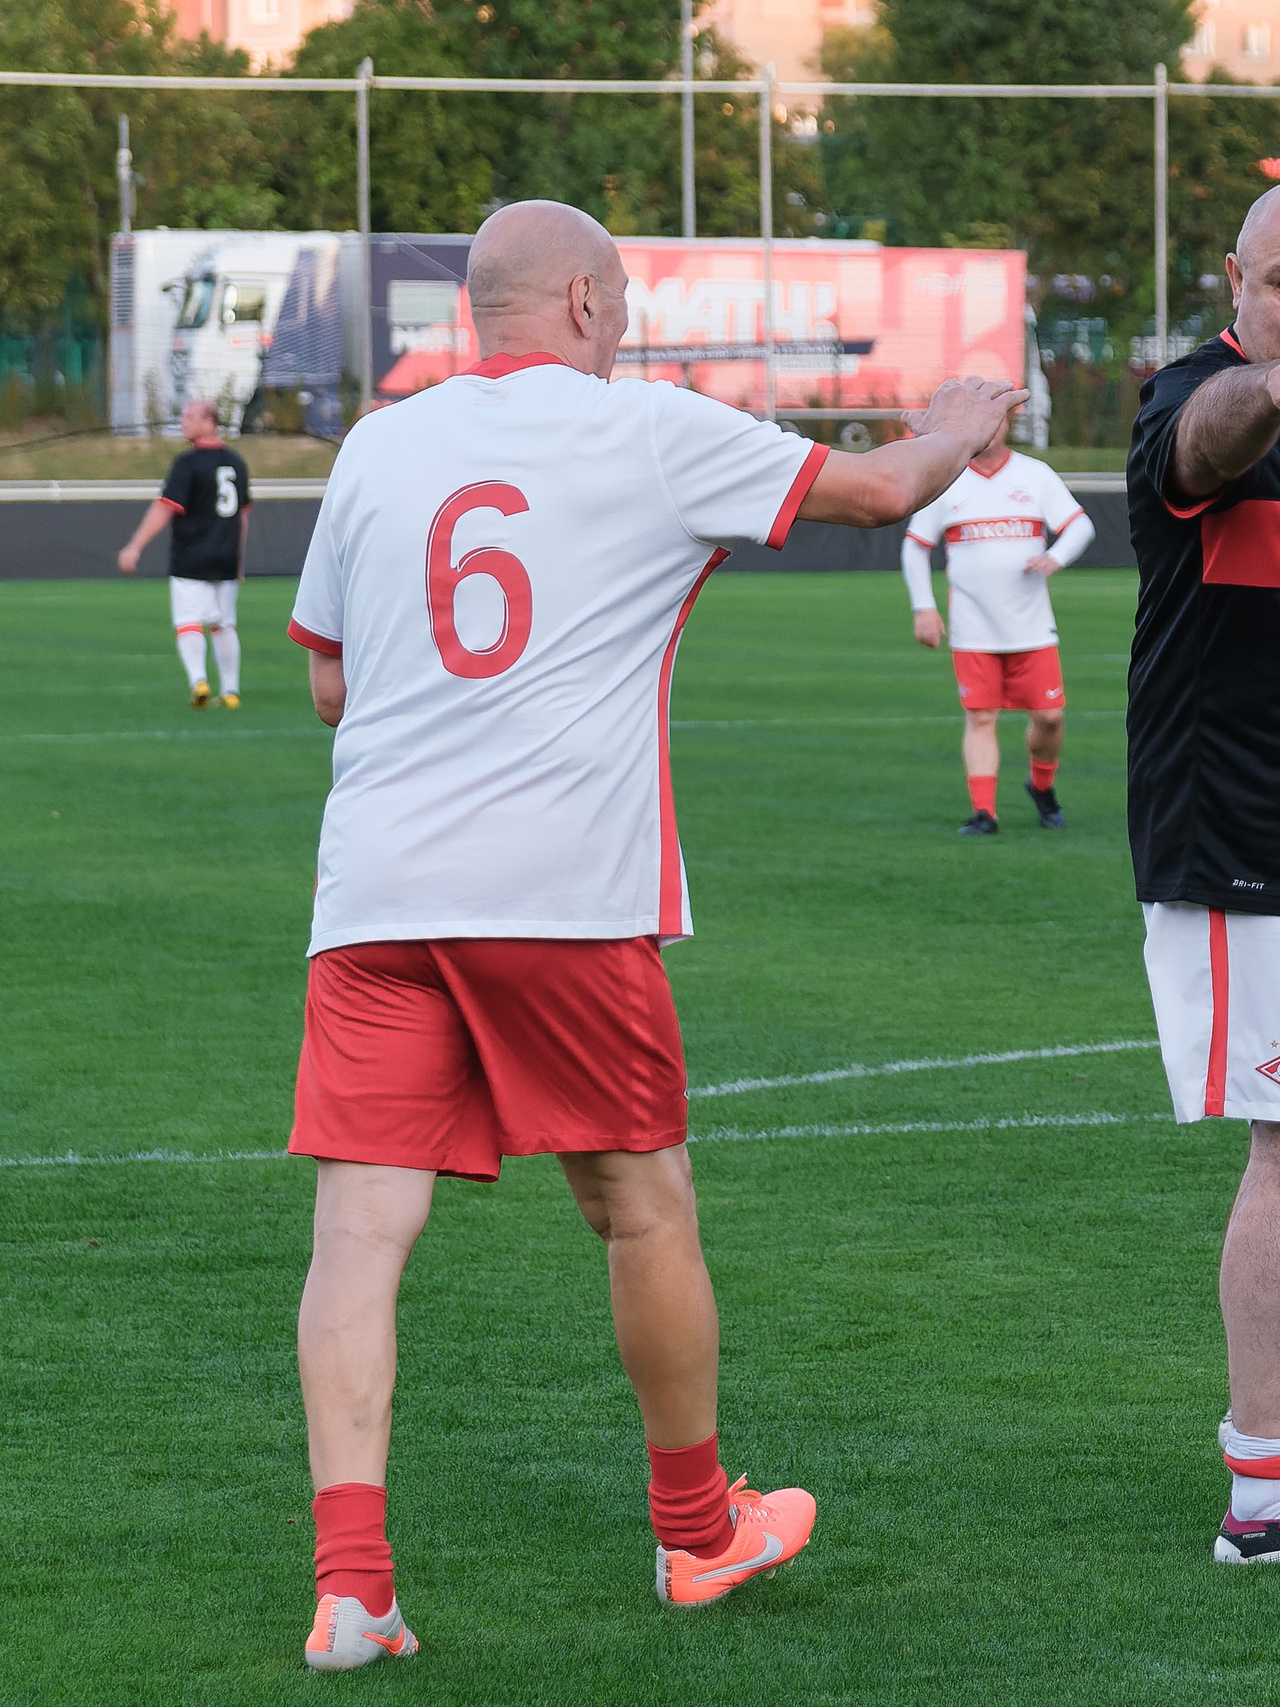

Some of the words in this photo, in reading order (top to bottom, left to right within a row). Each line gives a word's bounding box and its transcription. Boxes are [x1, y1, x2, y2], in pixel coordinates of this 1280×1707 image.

[215, 465, 239, 518] 5
[960, 517, 1034, 541] ЛУКОЙЛ
[425, 479, 533, 680] 6
[1232, 879, 1265, 890] DRI-FIT
